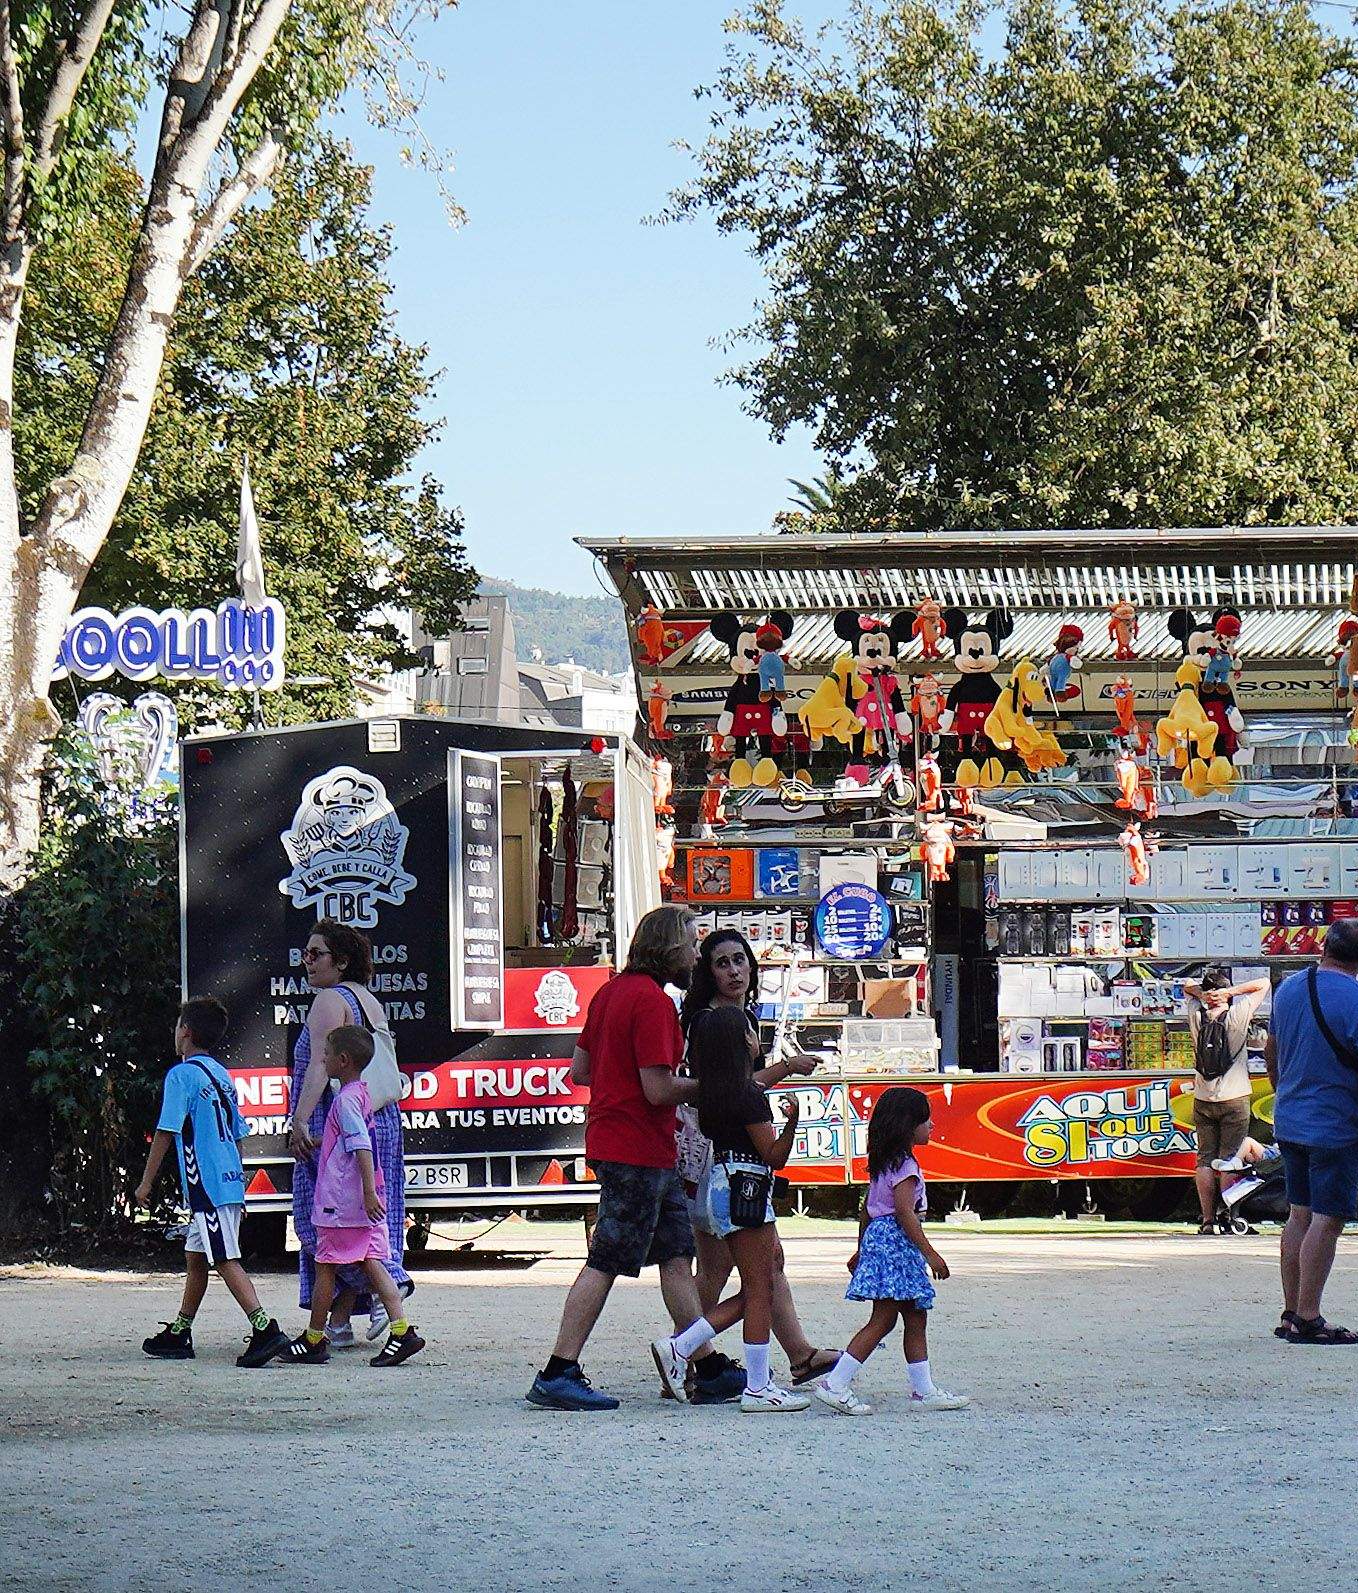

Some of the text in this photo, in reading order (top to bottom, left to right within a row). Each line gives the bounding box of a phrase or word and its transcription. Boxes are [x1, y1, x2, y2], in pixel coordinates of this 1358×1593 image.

[1236, 680, 1336, 691] SONY
[307, 862, 388, 884] COME BEBE Y CALLA
[843, 886, 877, 903] CUBO
[324, 892, 372, 923] CBC
[828, 906, 837, 916] 2
[823, 925, 839, 934] 25
[824, 916, 838, 925] 10
[450, 1066, 572, 1098] TRUCK
[1019, 1081, 1170, 1125] AQUÍ
[400, 1106, 586, 1129] ARA TUS EVENTOS
[1026, 1114, 1171, 1165] SI QUE
[426, 1167, 461, 1185] BSR
